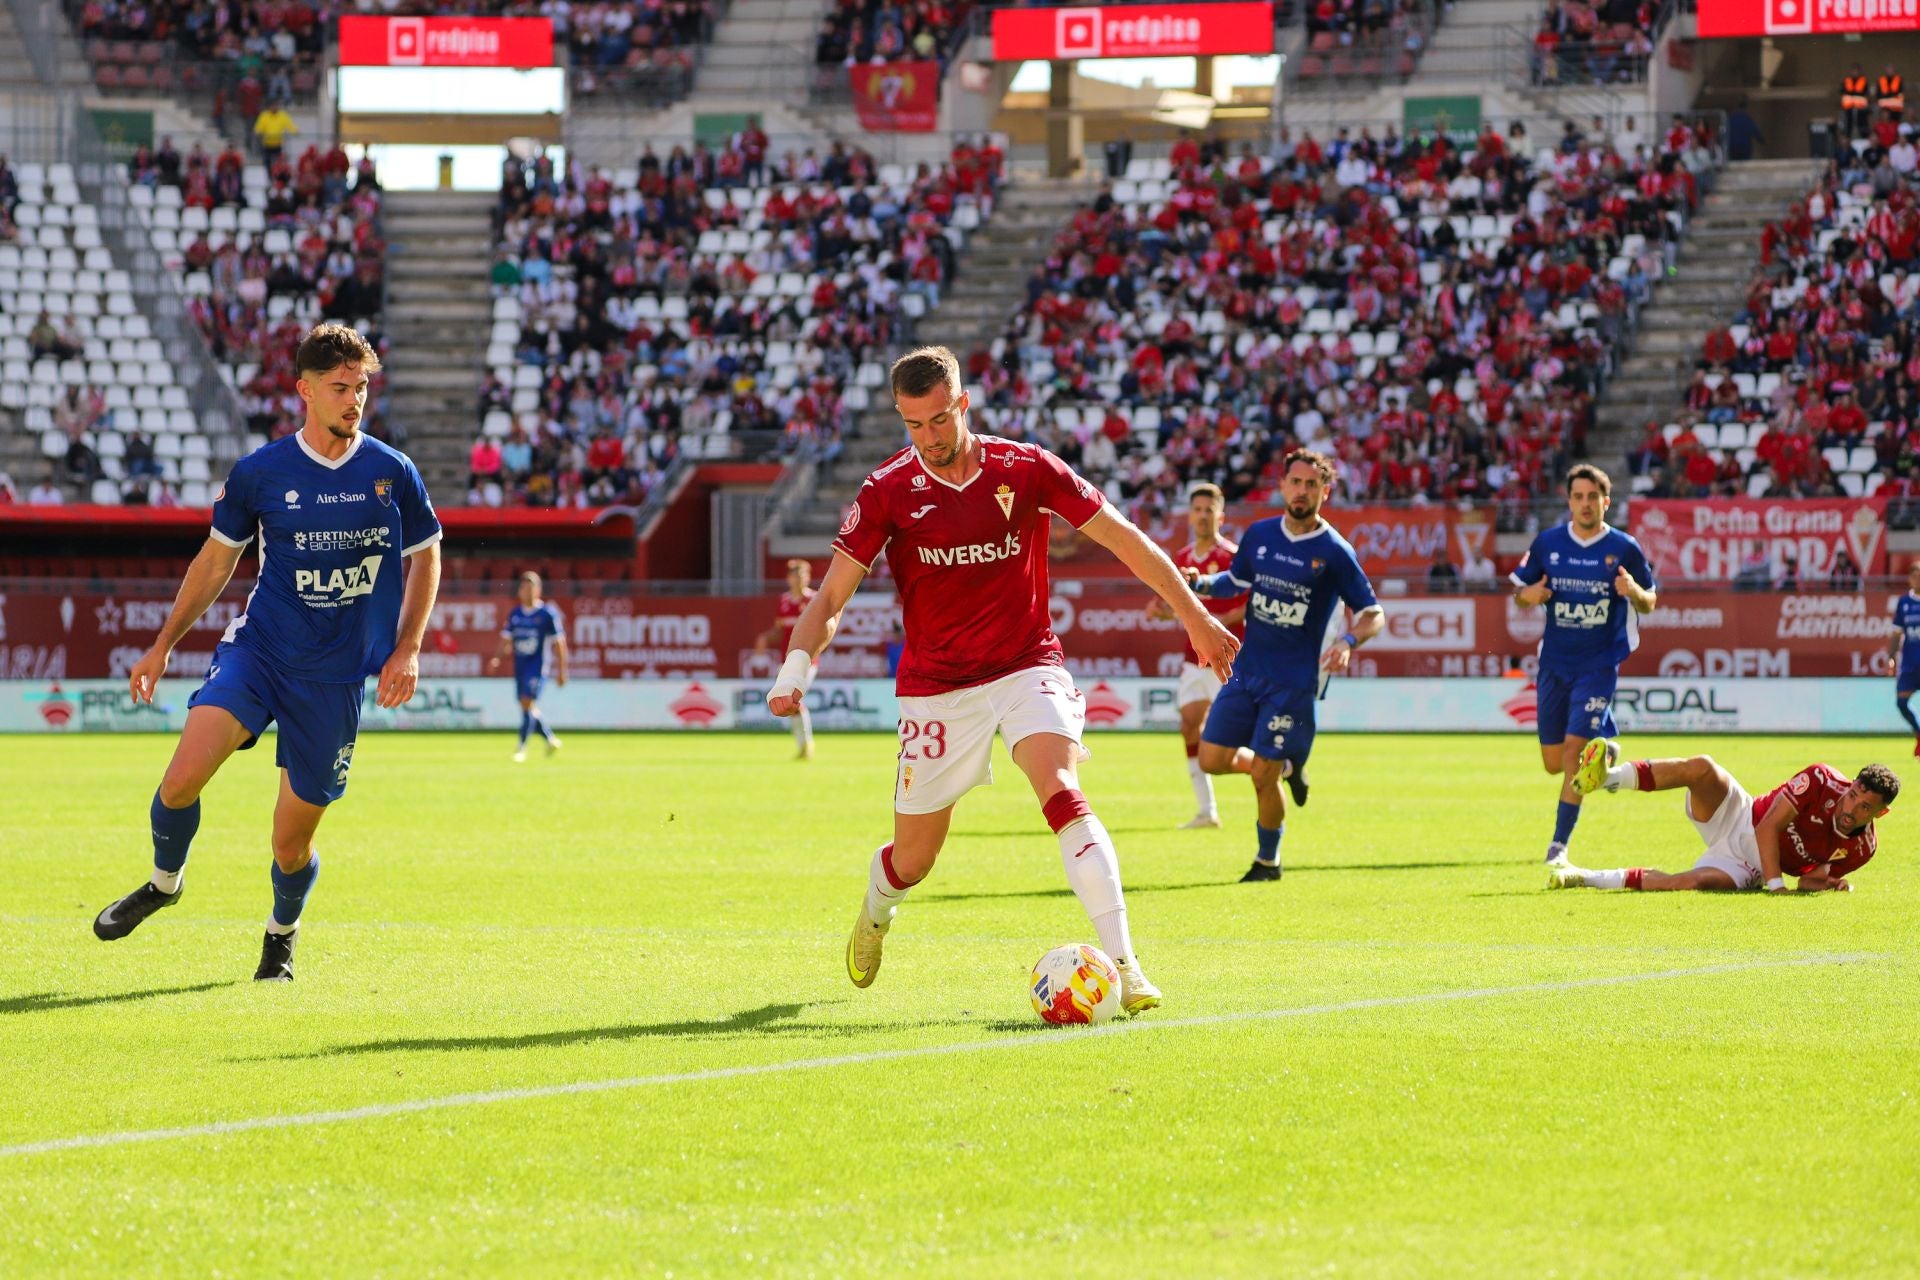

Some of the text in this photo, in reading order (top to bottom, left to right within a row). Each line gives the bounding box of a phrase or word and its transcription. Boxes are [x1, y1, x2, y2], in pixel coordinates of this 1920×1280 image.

[1106, 15, 1200, 45] redpiso
[316, 492, 366, 504] Aire Sano
[1765, 506, 1843, 533] Grana
[309, 526, 389, 541] FERTINAGRO
[310, 540, 363, 551] BIOTECH
[917, 531, 1021, 566] INVERSUS
[296, 562, 376, 592] PLATA
[1555, 600, 1608, 620] PLATA
[574, 615, 710, 645] marmo
[741, 689, 880, 713] POAL
[1612, 688, 1738, 713] ROAL
[902, 719, 946, 760] 23
